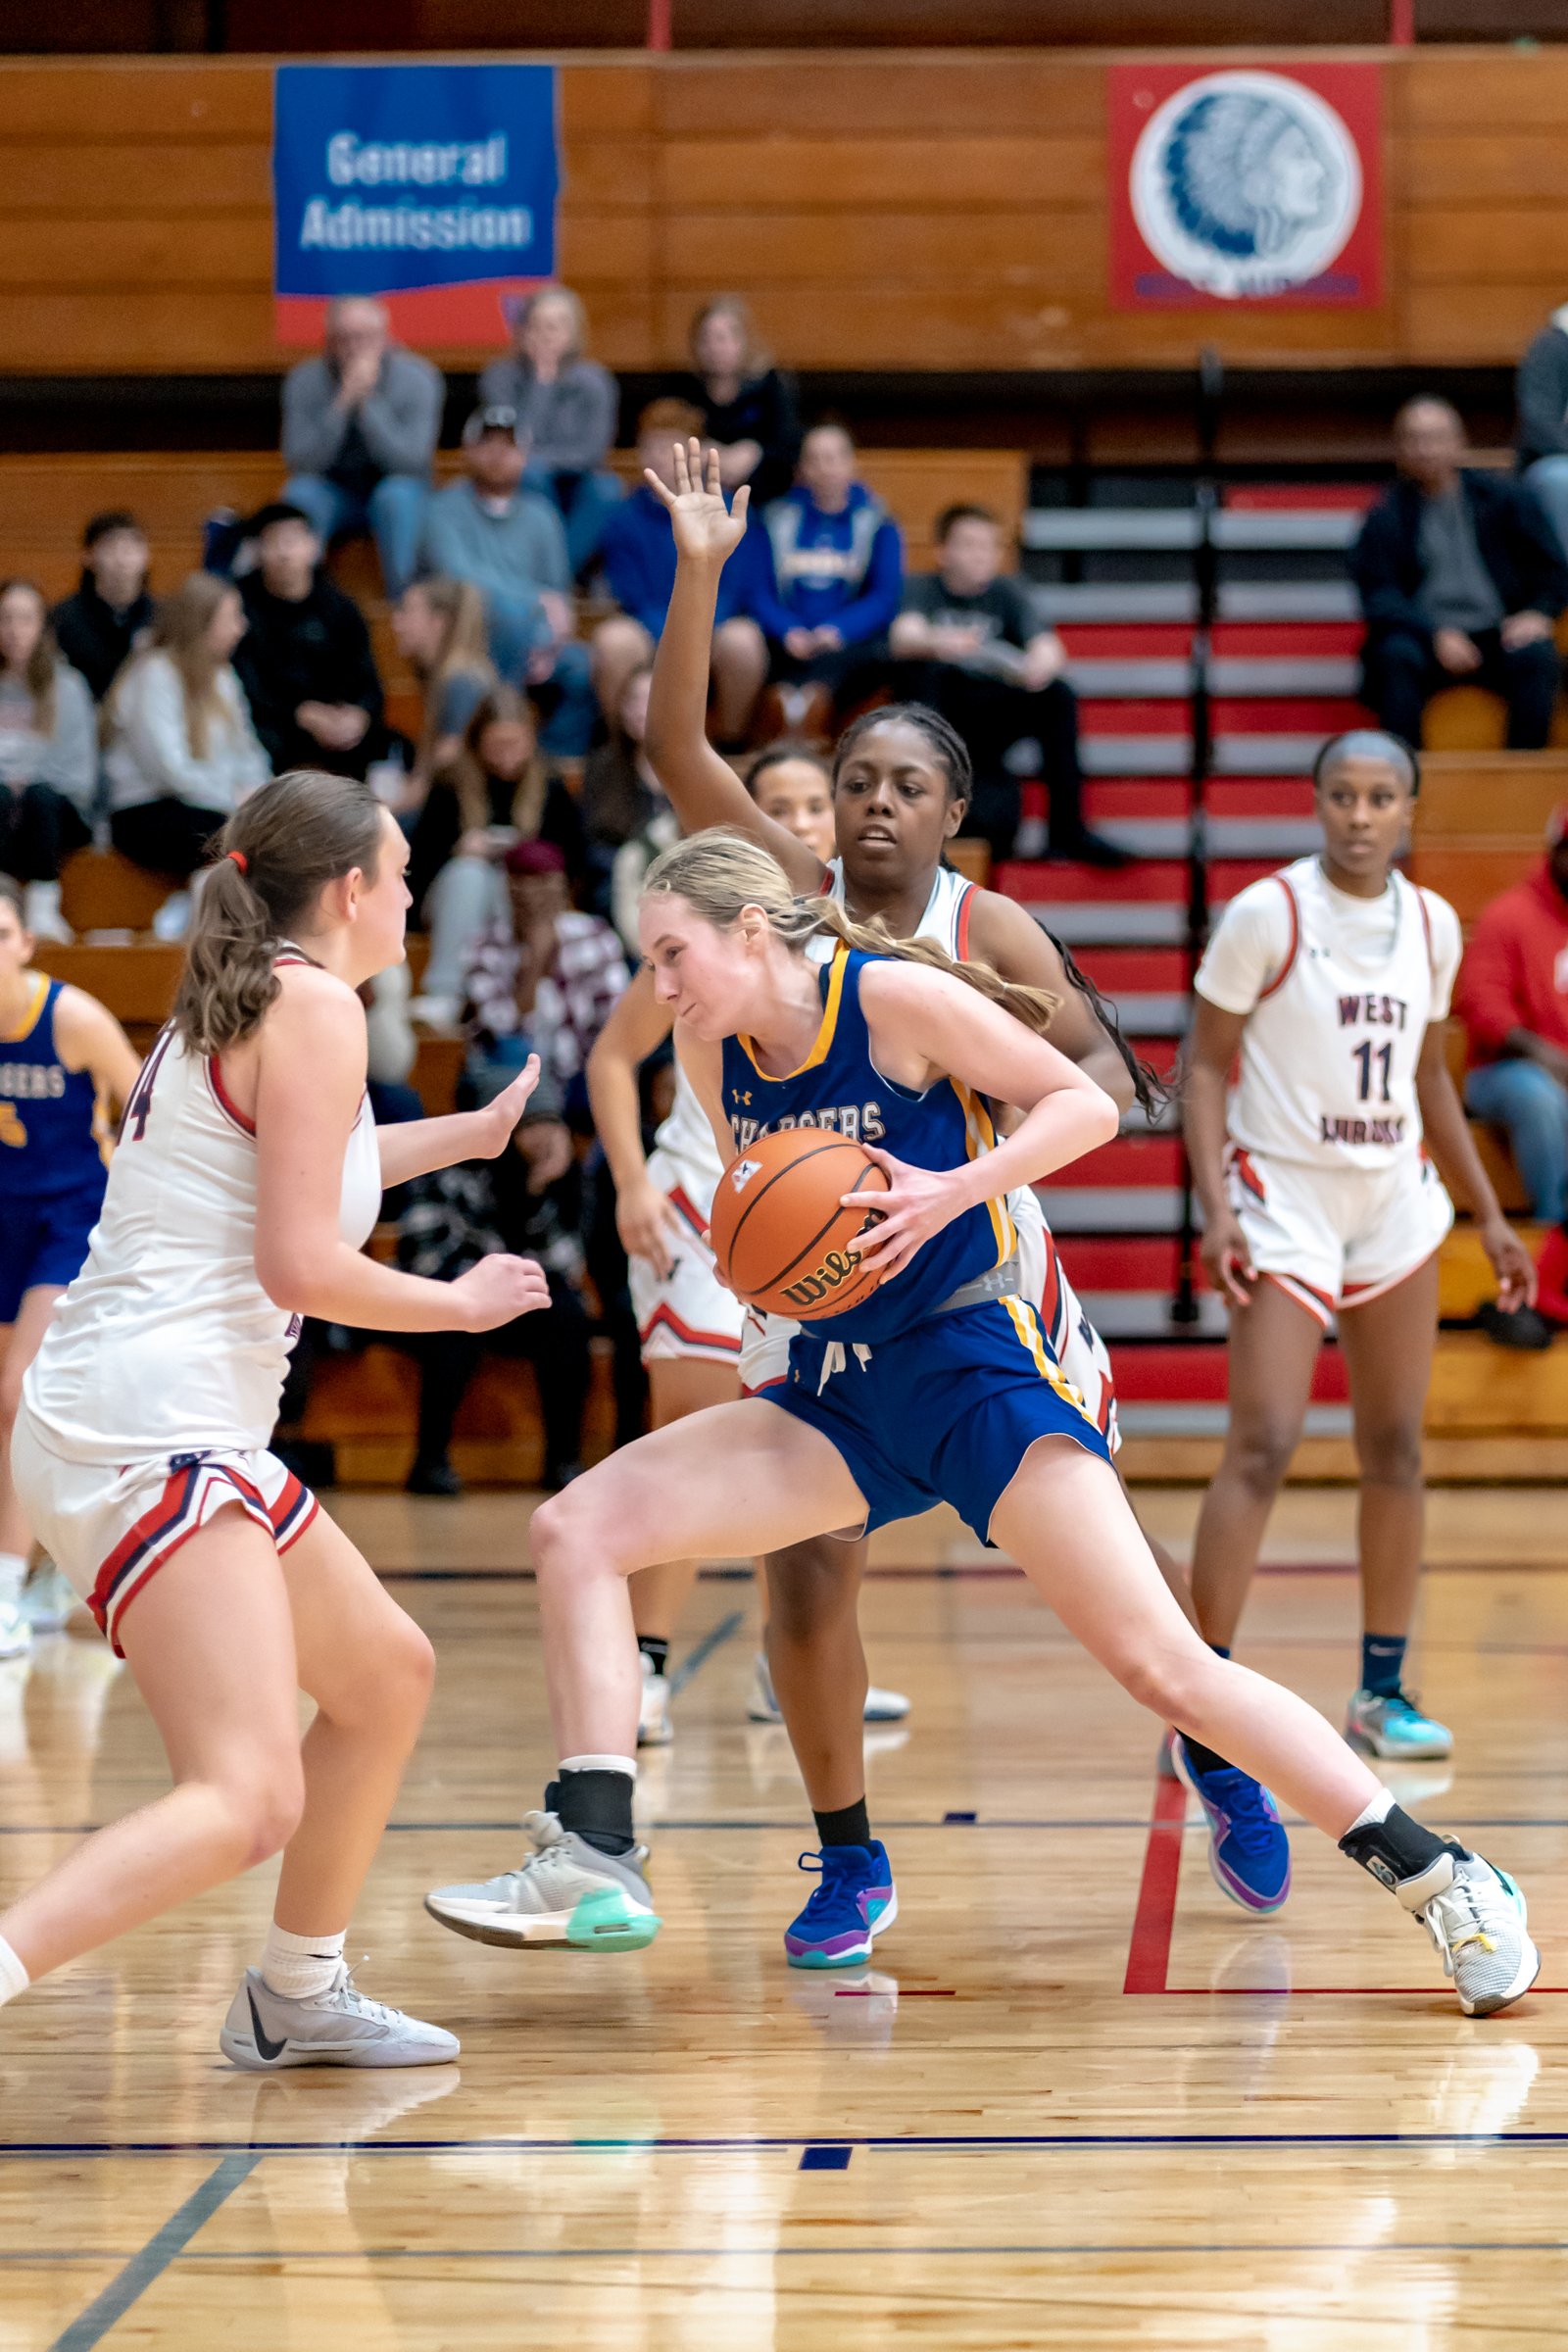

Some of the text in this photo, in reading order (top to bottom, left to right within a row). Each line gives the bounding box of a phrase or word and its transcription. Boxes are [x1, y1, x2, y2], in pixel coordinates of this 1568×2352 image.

[327, 133, 508, 185] General
[300, 198, 533, 251] Admission
[1339, 993, 1407, 1032] WEST
[1351, 1040, 1393, 1102] 11
[778, 1217, 878, 1307] Wils
